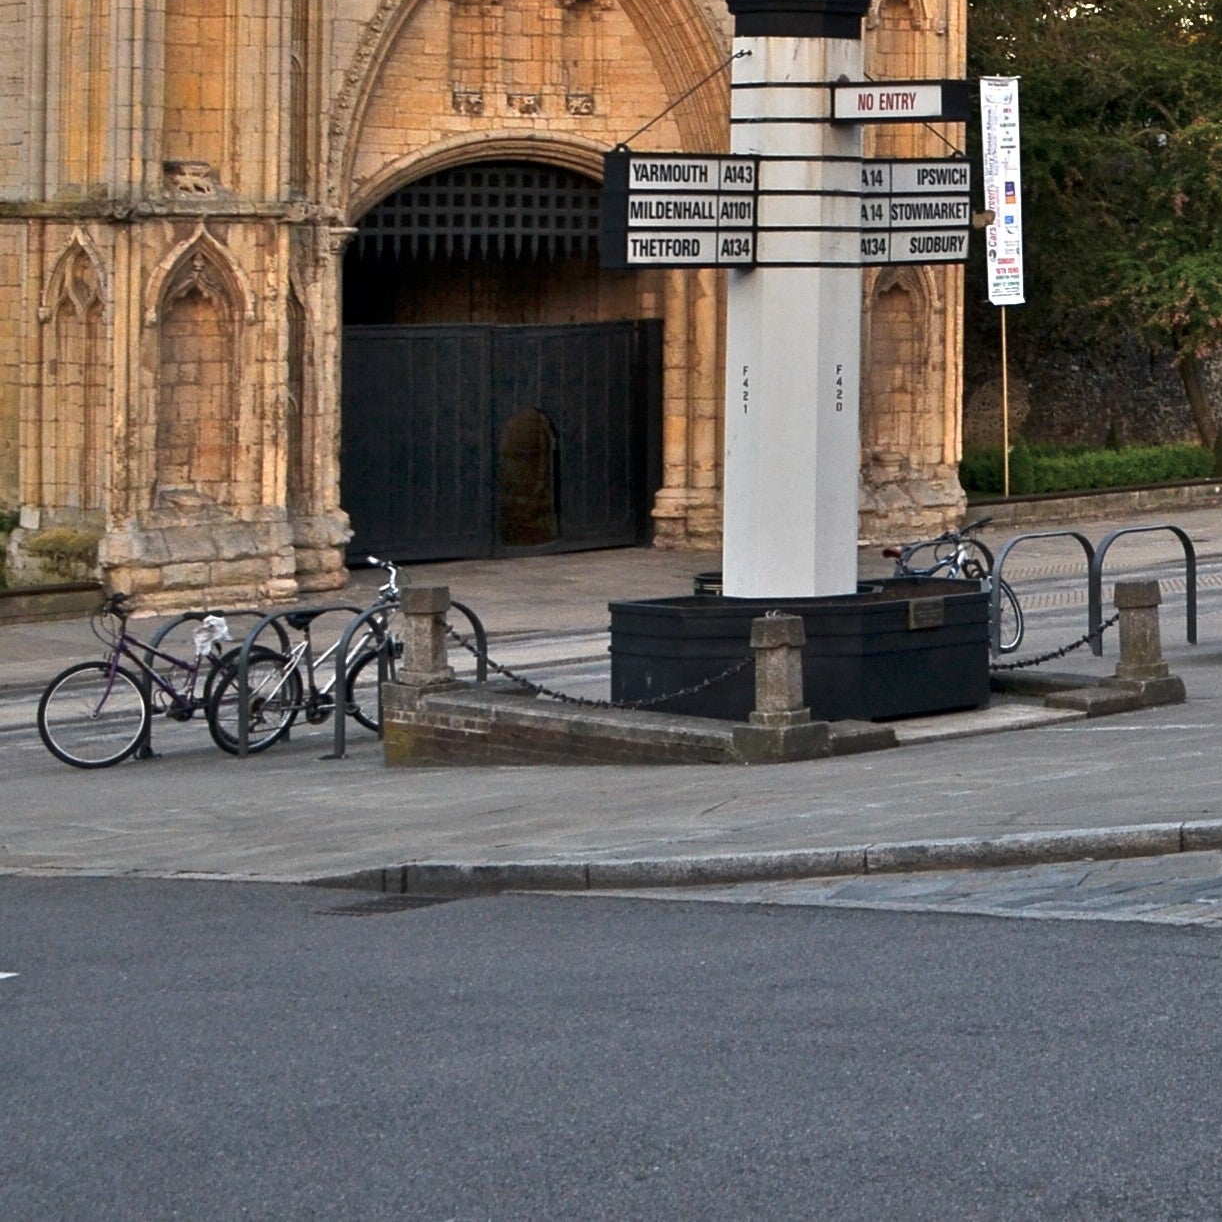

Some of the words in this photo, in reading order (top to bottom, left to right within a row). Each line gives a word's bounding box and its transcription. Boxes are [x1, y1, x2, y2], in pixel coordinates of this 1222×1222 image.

[857, 93, 874, 111] NO
[879, 92, 916, 111] ENTRY
[632, 163, 708, 183] YARMOUTH
[723, 165, 753, 184] A143
[861, 169, 883, 186] A14
[917, 168, 968, 186] IPSWICH
[630, 201, 716, 219] MILDENHALL
[720, 201, 752, 219] A1101
[861, 204, 883, 221] A14
[890, 202, 969, 221] STOWMARKET
[630, 238, 700, 257] THETFORD
[720, 238, 751, 257] A134
[860, 238, 886, 256] A134
[909, 235, 966, 254] SUDBURY
